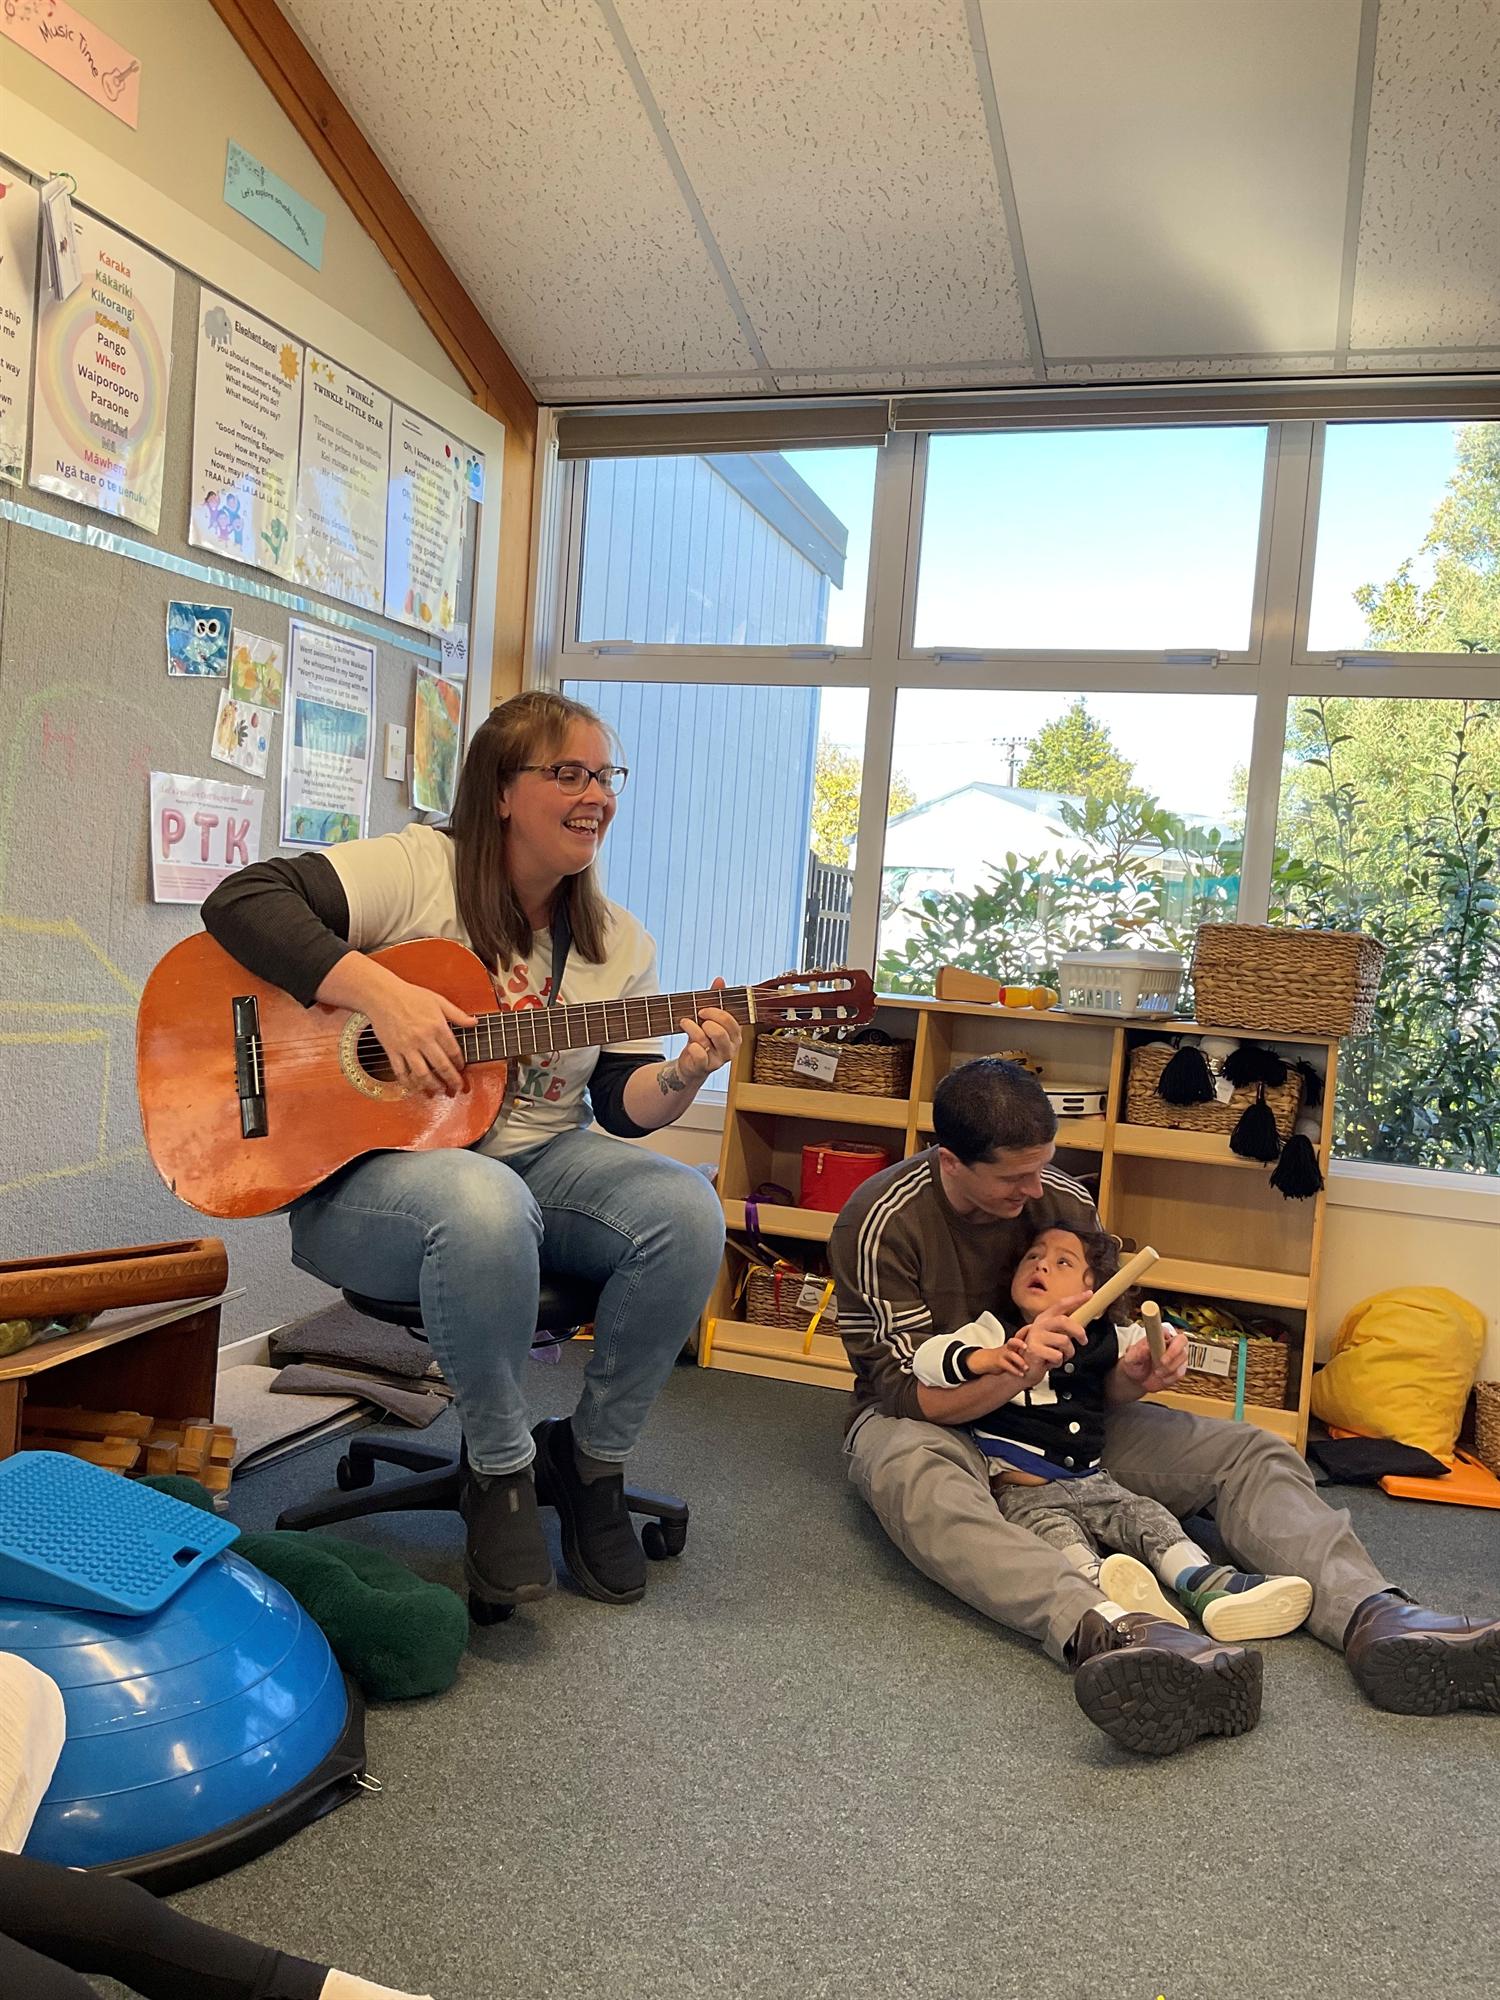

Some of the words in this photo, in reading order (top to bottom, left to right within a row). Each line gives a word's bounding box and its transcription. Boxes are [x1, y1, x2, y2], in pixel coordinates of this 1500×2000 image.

[39, 20, 75, 43] Music
[79, 32, 99, 78] Time
[98, 250, 131, 278] Karaka
[4, 307, 21, 325] ship
[91, 288, 135, 322] Kikorangi
[3, 325, 16, 339] me
[97, 332, 126, 356] Pango
[95, 351, 127, 376] Whero
[217, 343, 228, 353] you
[230, 350, 248, 365] should
[5, 361, 21, 377] way
[225, 361, 240, 374] upon
[77, 364, 139, 403] Waiporoporo
[226, 373, 241, 387] What
[242, 383, 259, 396] would
[260, 392, 269, 402] you
[91, 391, 130, 418] Paraone
[226, 386, 241, 400] What
[242, 396, 259, 409] would
[260, 405, 269, 414] you
[314, 382, 343, 405] TWINKLE
[344, 401, 366, 419] LITTLE
[367, 414, 383, 429] STAR
[346, 385, 373, 408] TWINKLE
[240, 419, 256, 433] You'd
[84, 450, 128, 477] Māwhero
[214, 447, 235, 464] Lovely
[235, 443, 247, 455] How
[249, 451, 257, 459] are
[258, 456, 270, 465] you?
[56, 460, 77, 479] Ngā
[79, 469, 96, 485] tae
[98, 476, 105, 488] o
[106, 478, 117, 493] te
[211, 458, 227, 473] Now,
[228, 467, 240, 480] may
[405, 466, 415, 477] And
[205, 469, 221, 483] TRAA
[223, 477, 235, 488] LAA
[242, 485, 250, 494] LA
[251, 488, 258, 498] LA
[259, 492, 265, 500] LA
[267, 496, 273, 504] LA
[161, 808, 250, 865] PTK
